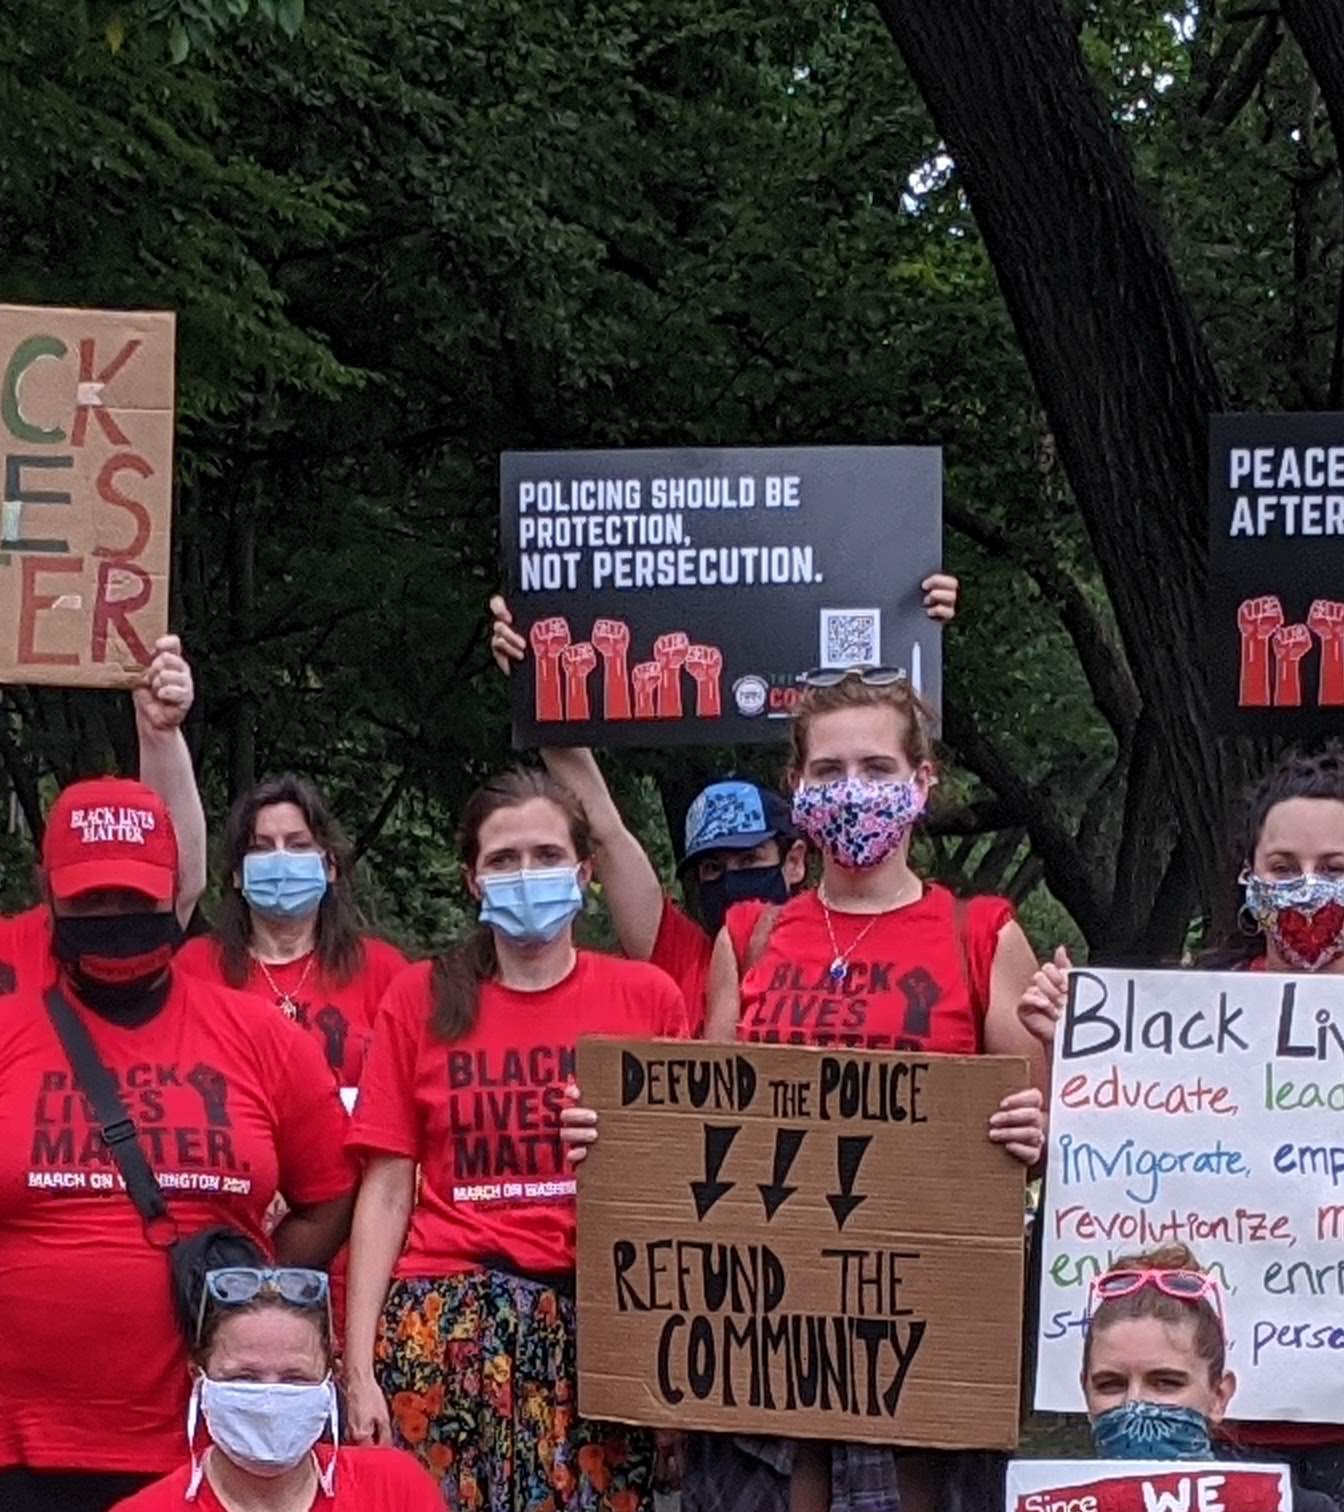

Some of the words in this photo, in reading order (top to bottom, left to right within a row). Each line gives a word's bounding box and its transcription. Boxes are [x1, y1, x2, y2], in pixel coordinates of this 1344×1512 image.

[520, 479, 641, 513] POLICING
[651, 476, 755, 509] SHOULD
[765, 476, 800, 508] BE
[520, 514, 691, 548] PROTECTION,
[520, 552, 580, 590] NOT
[593, 545, 823, 588] PERSECUTION.
[70, 806, 115, 828] BLACK
[119, 808, 155, 830] LIVES
[81, 825, 144, 844] MATTER
[768, 959, 896, 995] BLACK
[752, 993, 868, 1027] LIVES
[1060, 970, 1249, 1061] Black
[42, 1063, 186, 1092] BCK
[620, 1050, 756, 1112] DEFUND
[768, 1079, 811, 1119] THE
[819, 1057, 931, 1124] POLICE
[1059, 1073, 1240, 1116] educate,
[35, 1090, 166, 1123] LIVS
[449, 1088, 565, 1135] LIVES
[30, 1127, 251, 1172] MATER.
[453, 1133, 565, 1180] MATT
[1059, 1132, 1252, 1204] invigorate,
[28, 1172, 85, 1188] MARCH
[90, 1173, 114, 1189] ON
[453, 1182, 500, 1202] MARCH
[1054, 1205, 1298, 1245] revolutionize,
[613, 1239, 786, 1314] REFUND
[821, 1248, 921, 1316] THE
[658, 1313, 927, 1417] COMMUNITY
